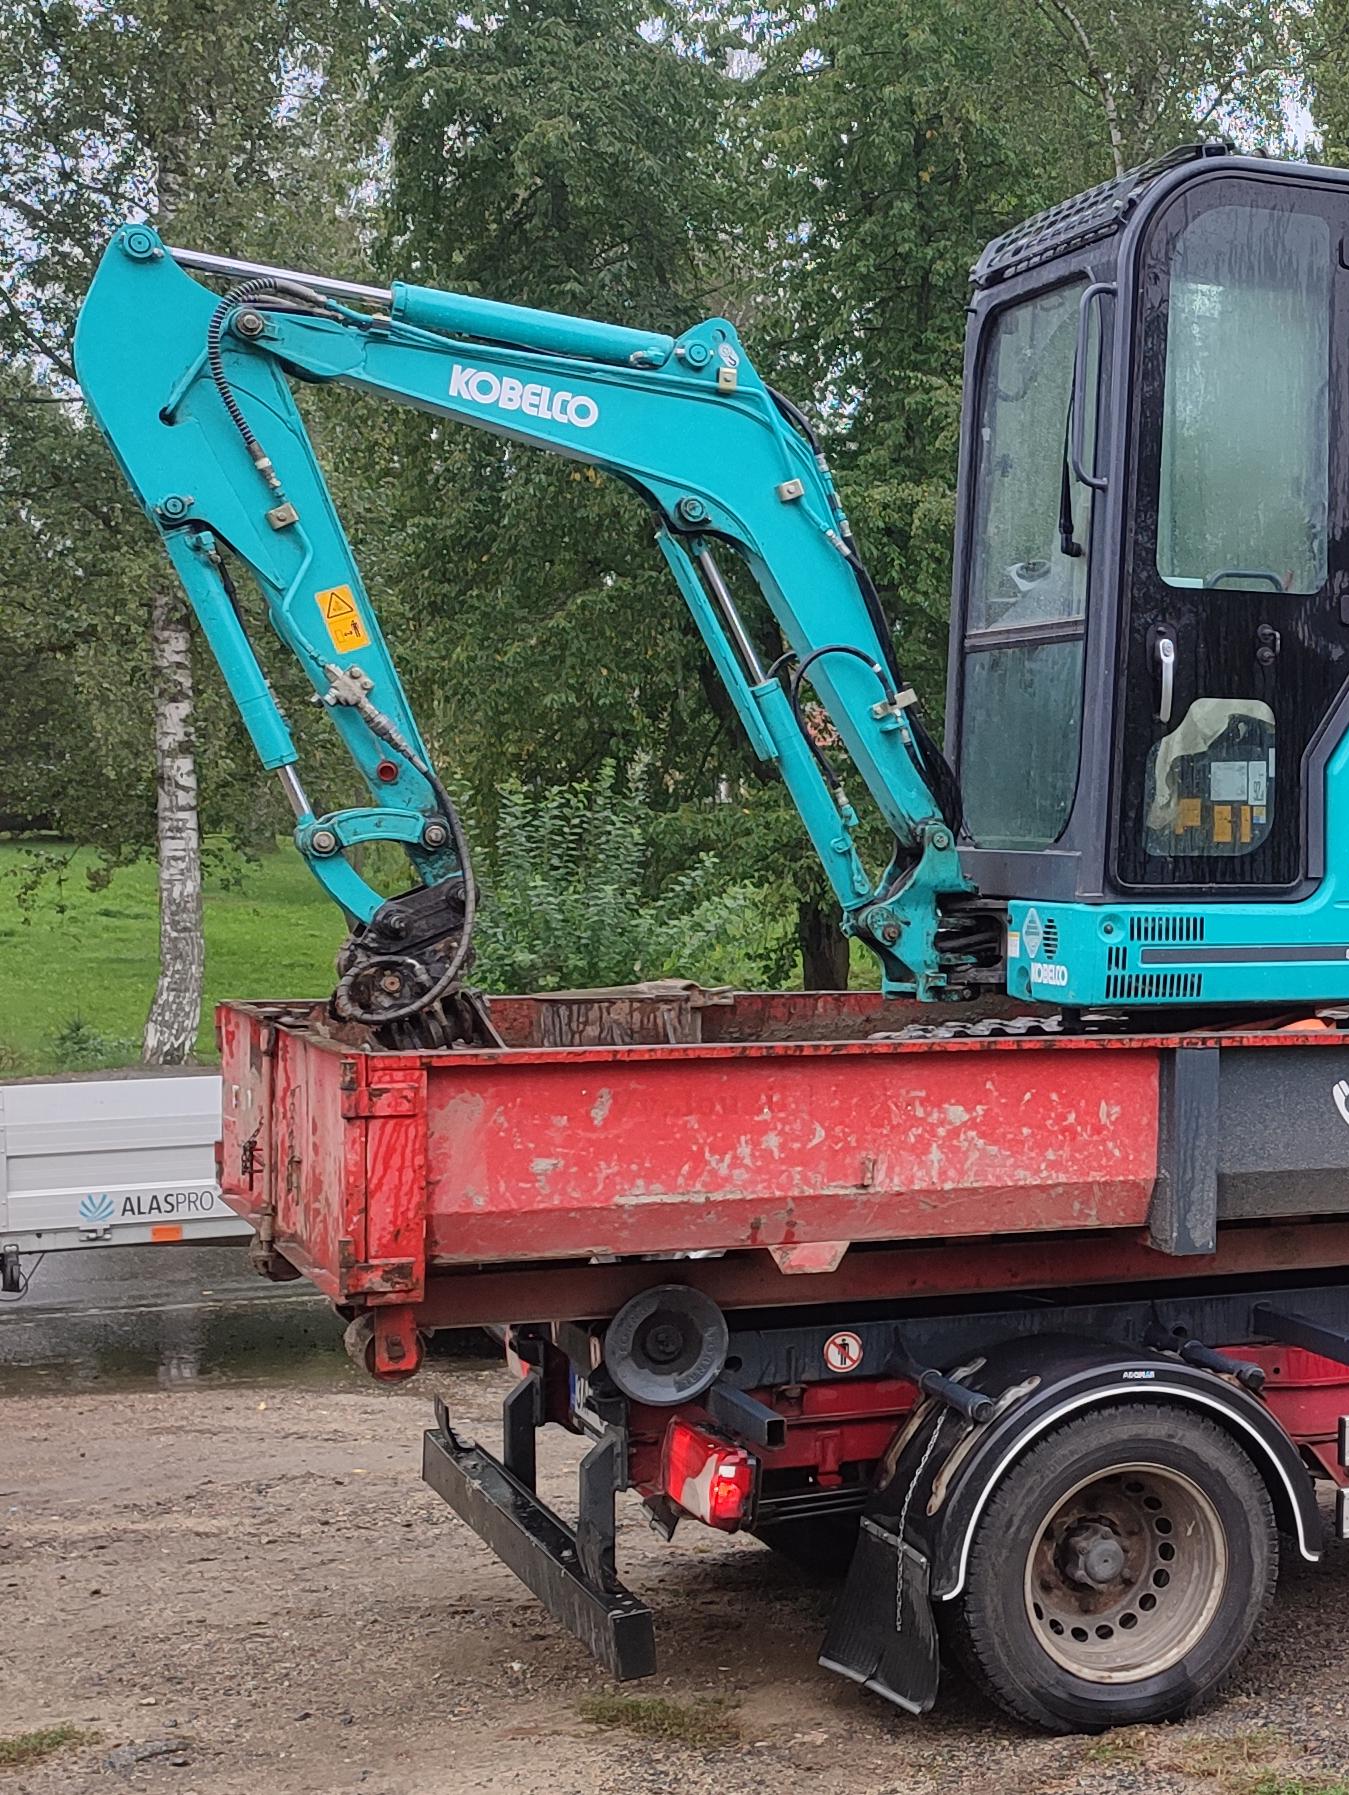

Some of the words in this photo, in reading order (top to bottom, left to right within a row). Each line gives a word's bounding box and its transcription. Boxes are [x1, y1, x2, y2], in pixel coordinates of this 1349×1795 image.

[448, 363, 599, 428] KOBELCO
[1031, 962, 1068, 987] KOBELCO
[121, 1190, 215, 1217] ALASPRO
